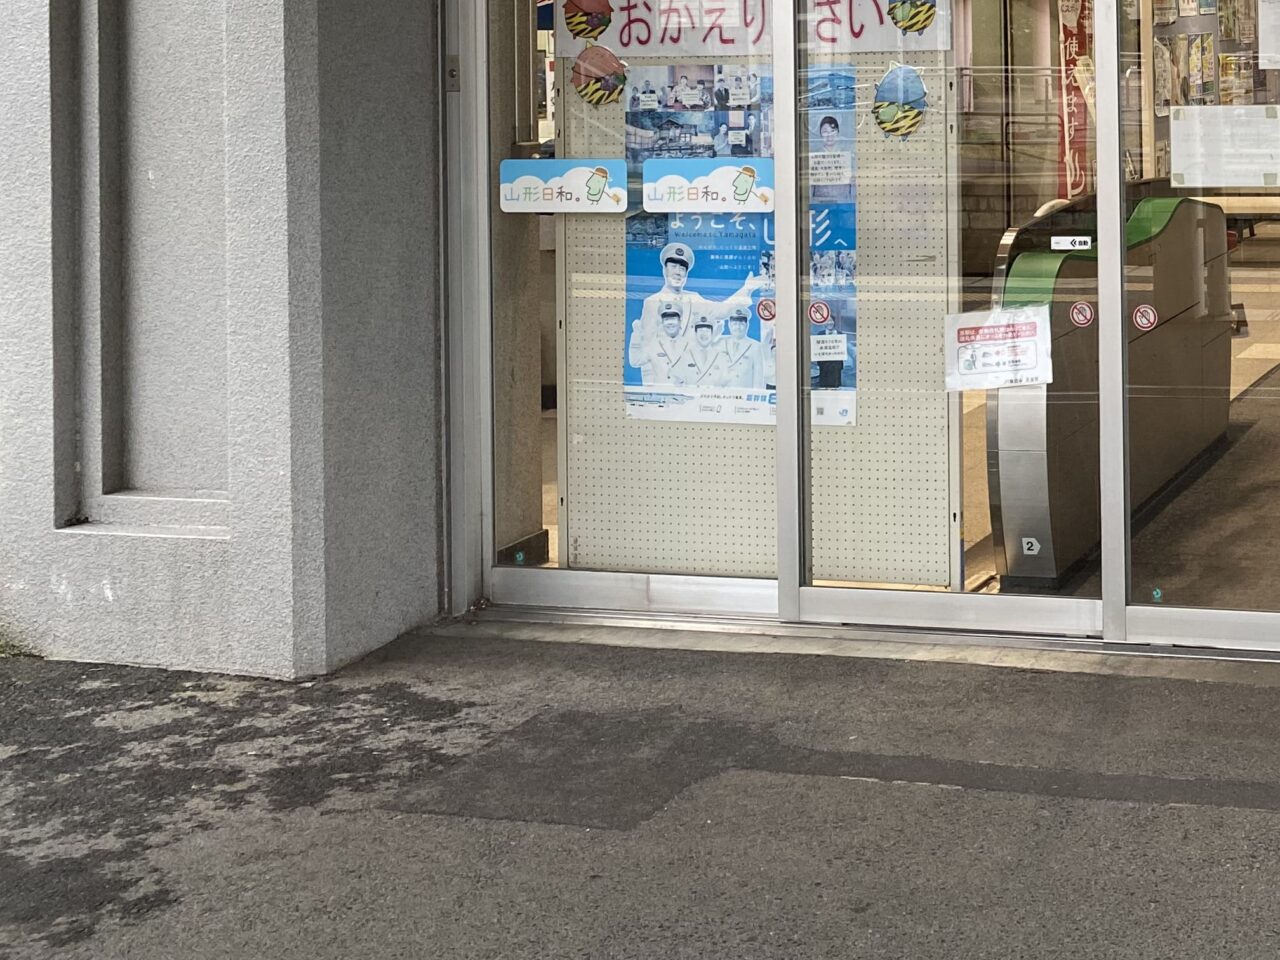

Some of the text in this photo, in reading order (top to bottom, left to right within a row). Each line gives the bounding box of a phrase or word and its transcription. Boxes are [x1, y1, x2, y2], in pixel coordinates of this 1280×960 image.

[504, 187, 581, 203] 山形日和。
[647, 186, 727, 203] 山形日和。
[1026, 541, 1035, 552] 2
